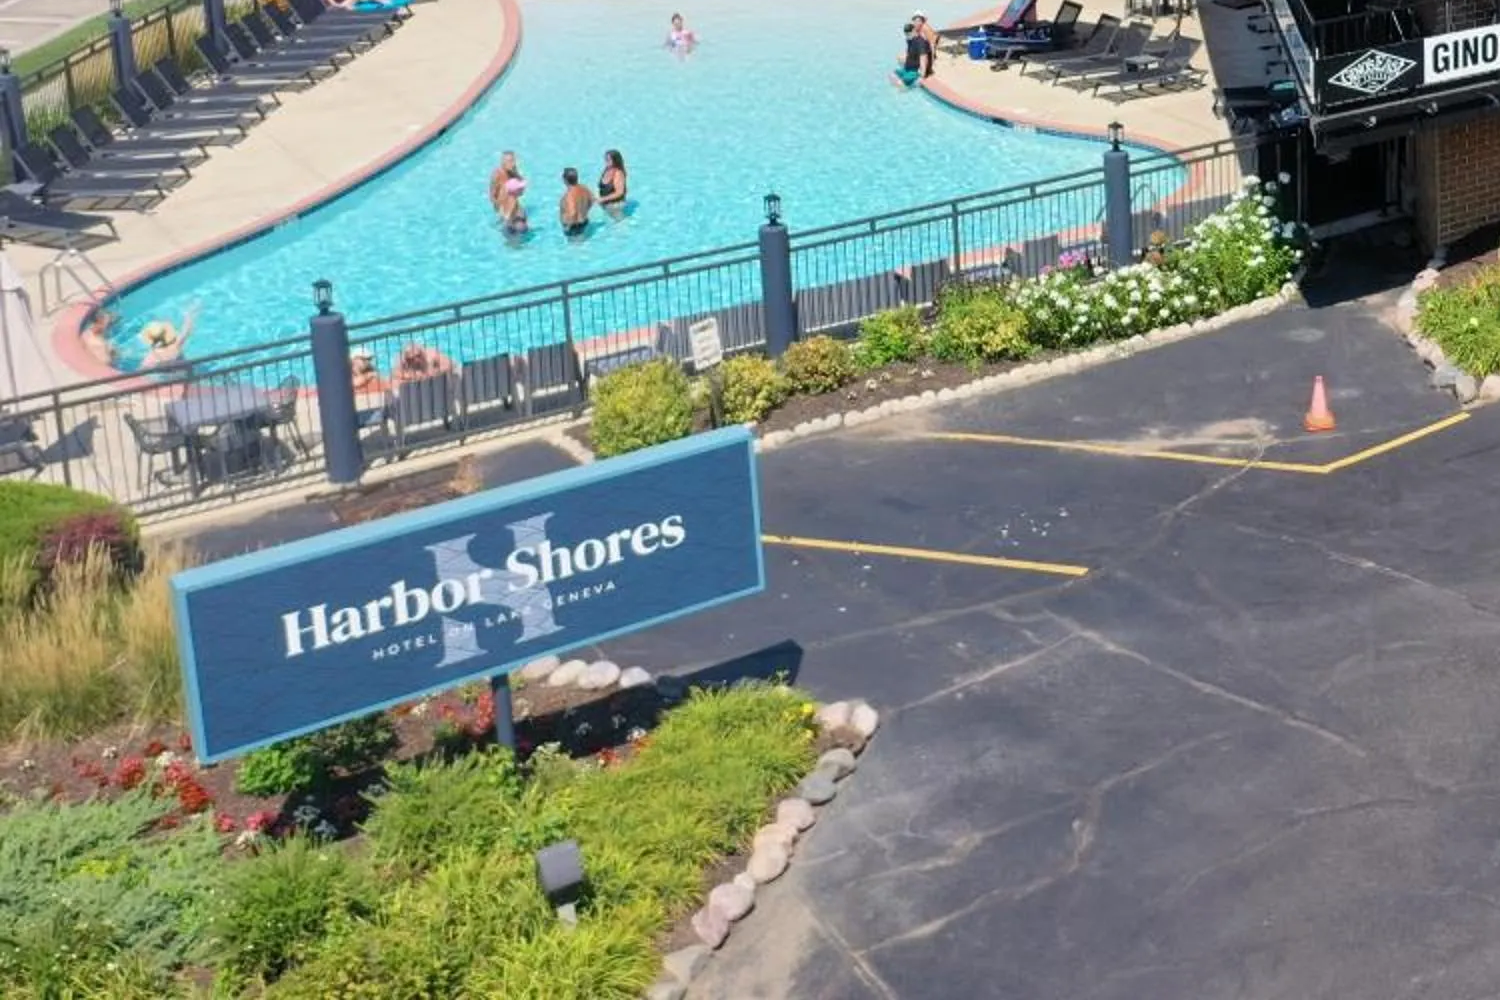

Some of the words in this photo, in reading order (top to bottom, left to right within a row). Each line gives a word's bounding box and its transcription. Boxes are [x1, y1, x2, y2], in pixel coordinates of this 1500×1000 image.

[281, 567, 494, 658] Harbor
[506, 514, 687, 591] Shores
[371, 633, 438, 661] HOTEL
